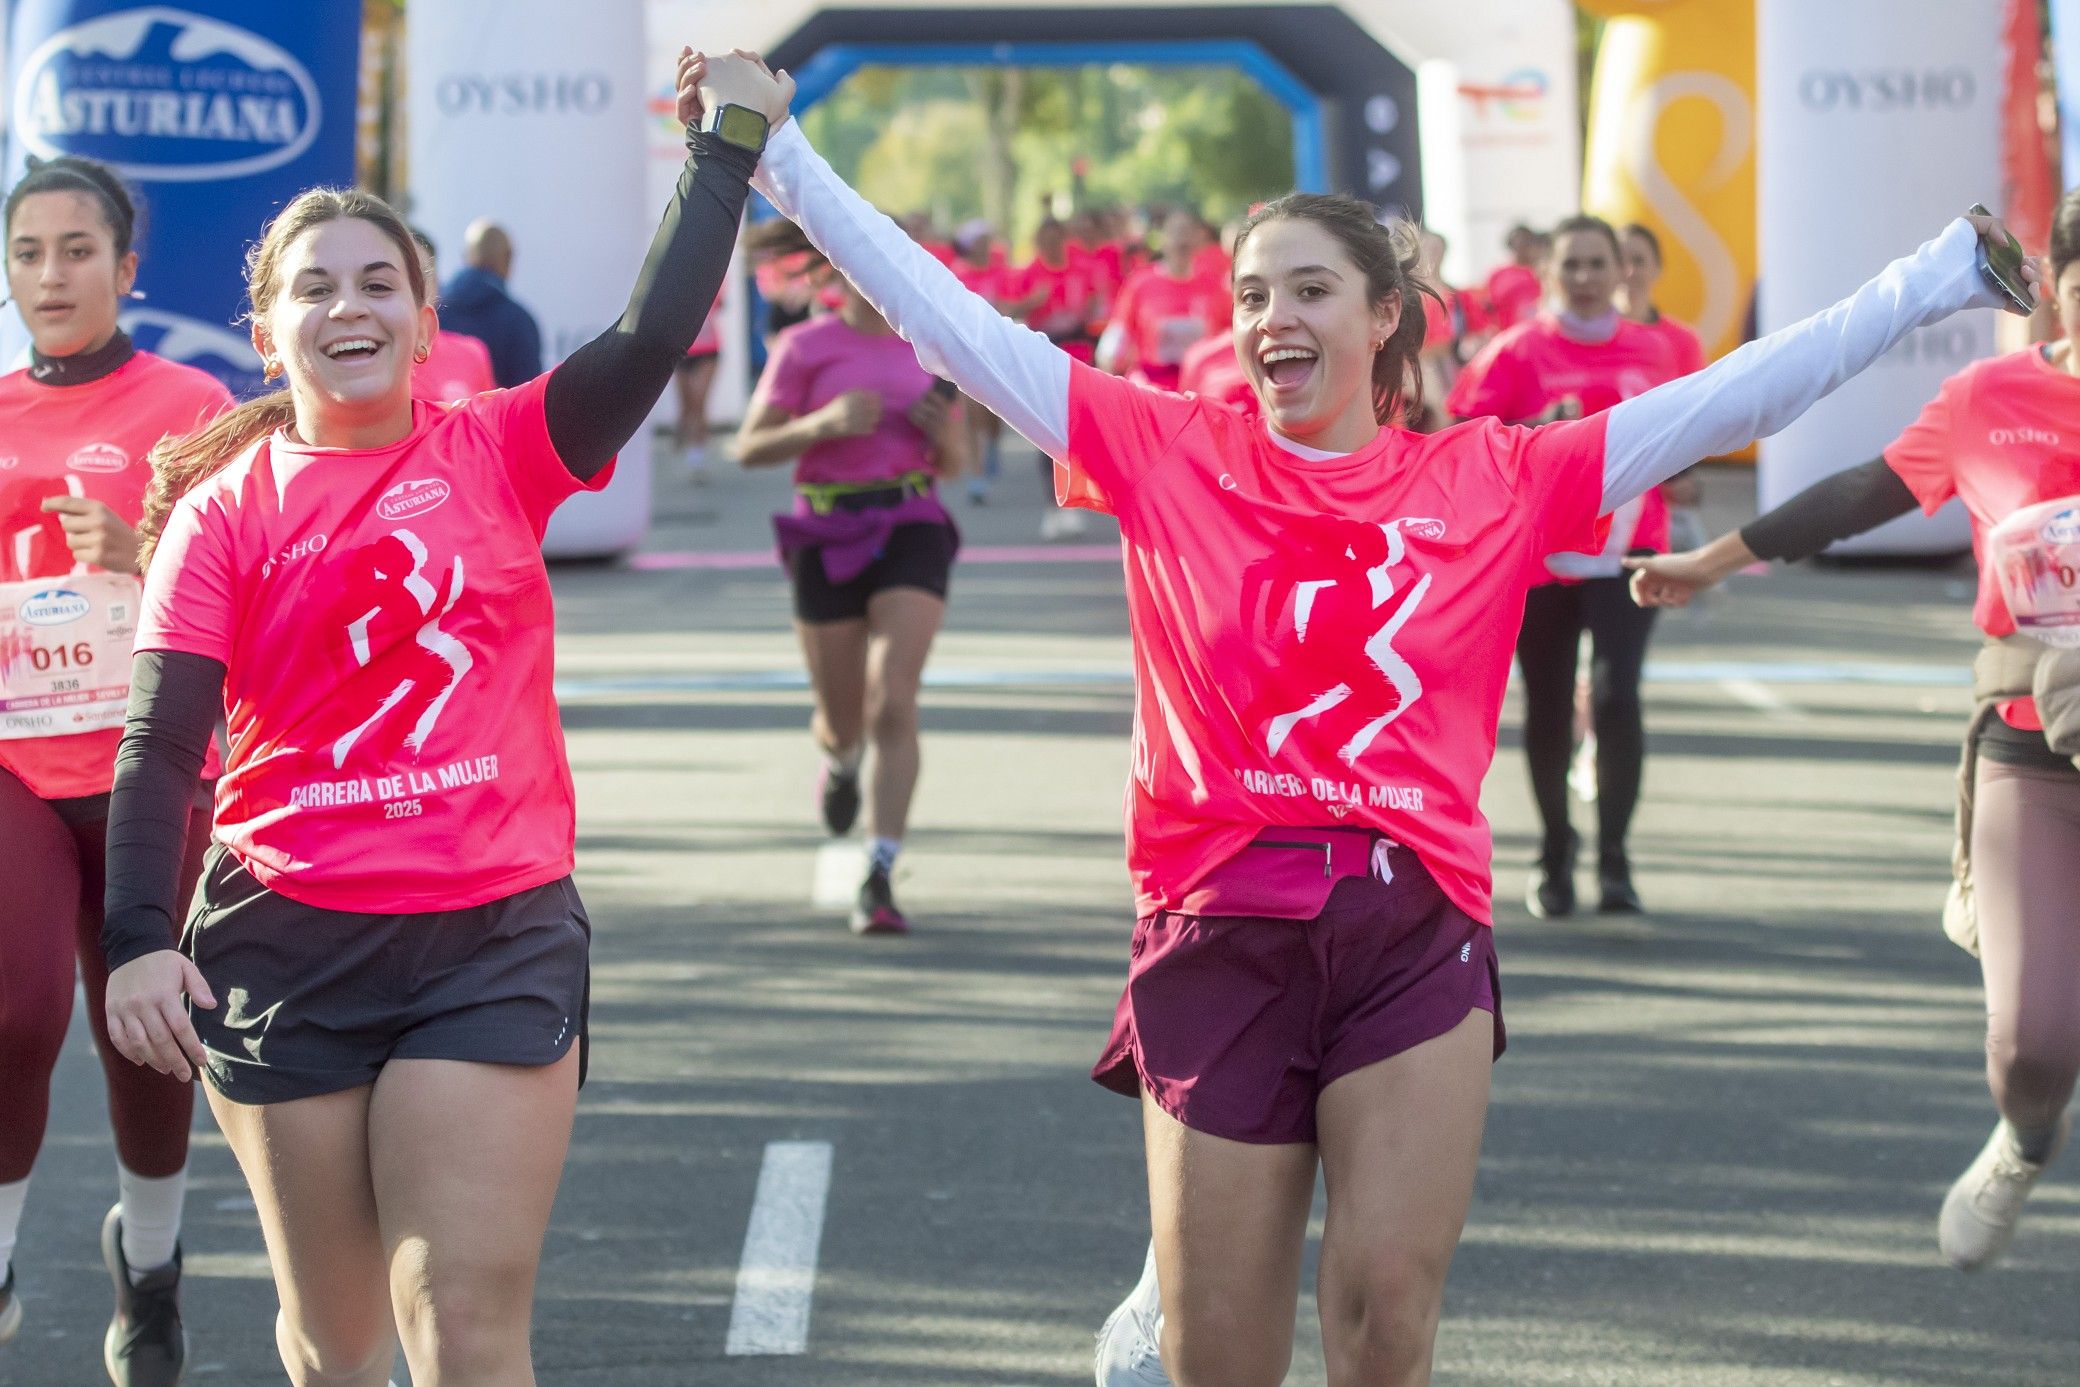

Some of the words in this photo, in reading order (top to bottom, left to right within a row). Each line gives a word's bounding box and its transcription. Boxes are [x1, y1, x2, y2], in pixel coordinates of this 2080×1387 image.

[28, 67, 300, 144] ASTURIANA
[435, 72, 612, 116] OYSHO
[1799, 67, 1976, 113] OYSHO
[1989, 428, 2059, 446] OYSHO
[383, 487, 446, 516] ASTURIANA
[25, 603, 85, 618] ASTURIANA
[6, 715, 52, 728] OYSHO
[289, 778, 373, 808] CARRERA
[376, 775, 405, 800] DE
[408, 772, 437, 795] LA
[437, 755, 499, 789] MUJER
[1311, 778, 1339, 801] DE
[1368, 786, 1424, 811] MUJER
[384, 799, 422, 819] 2025
